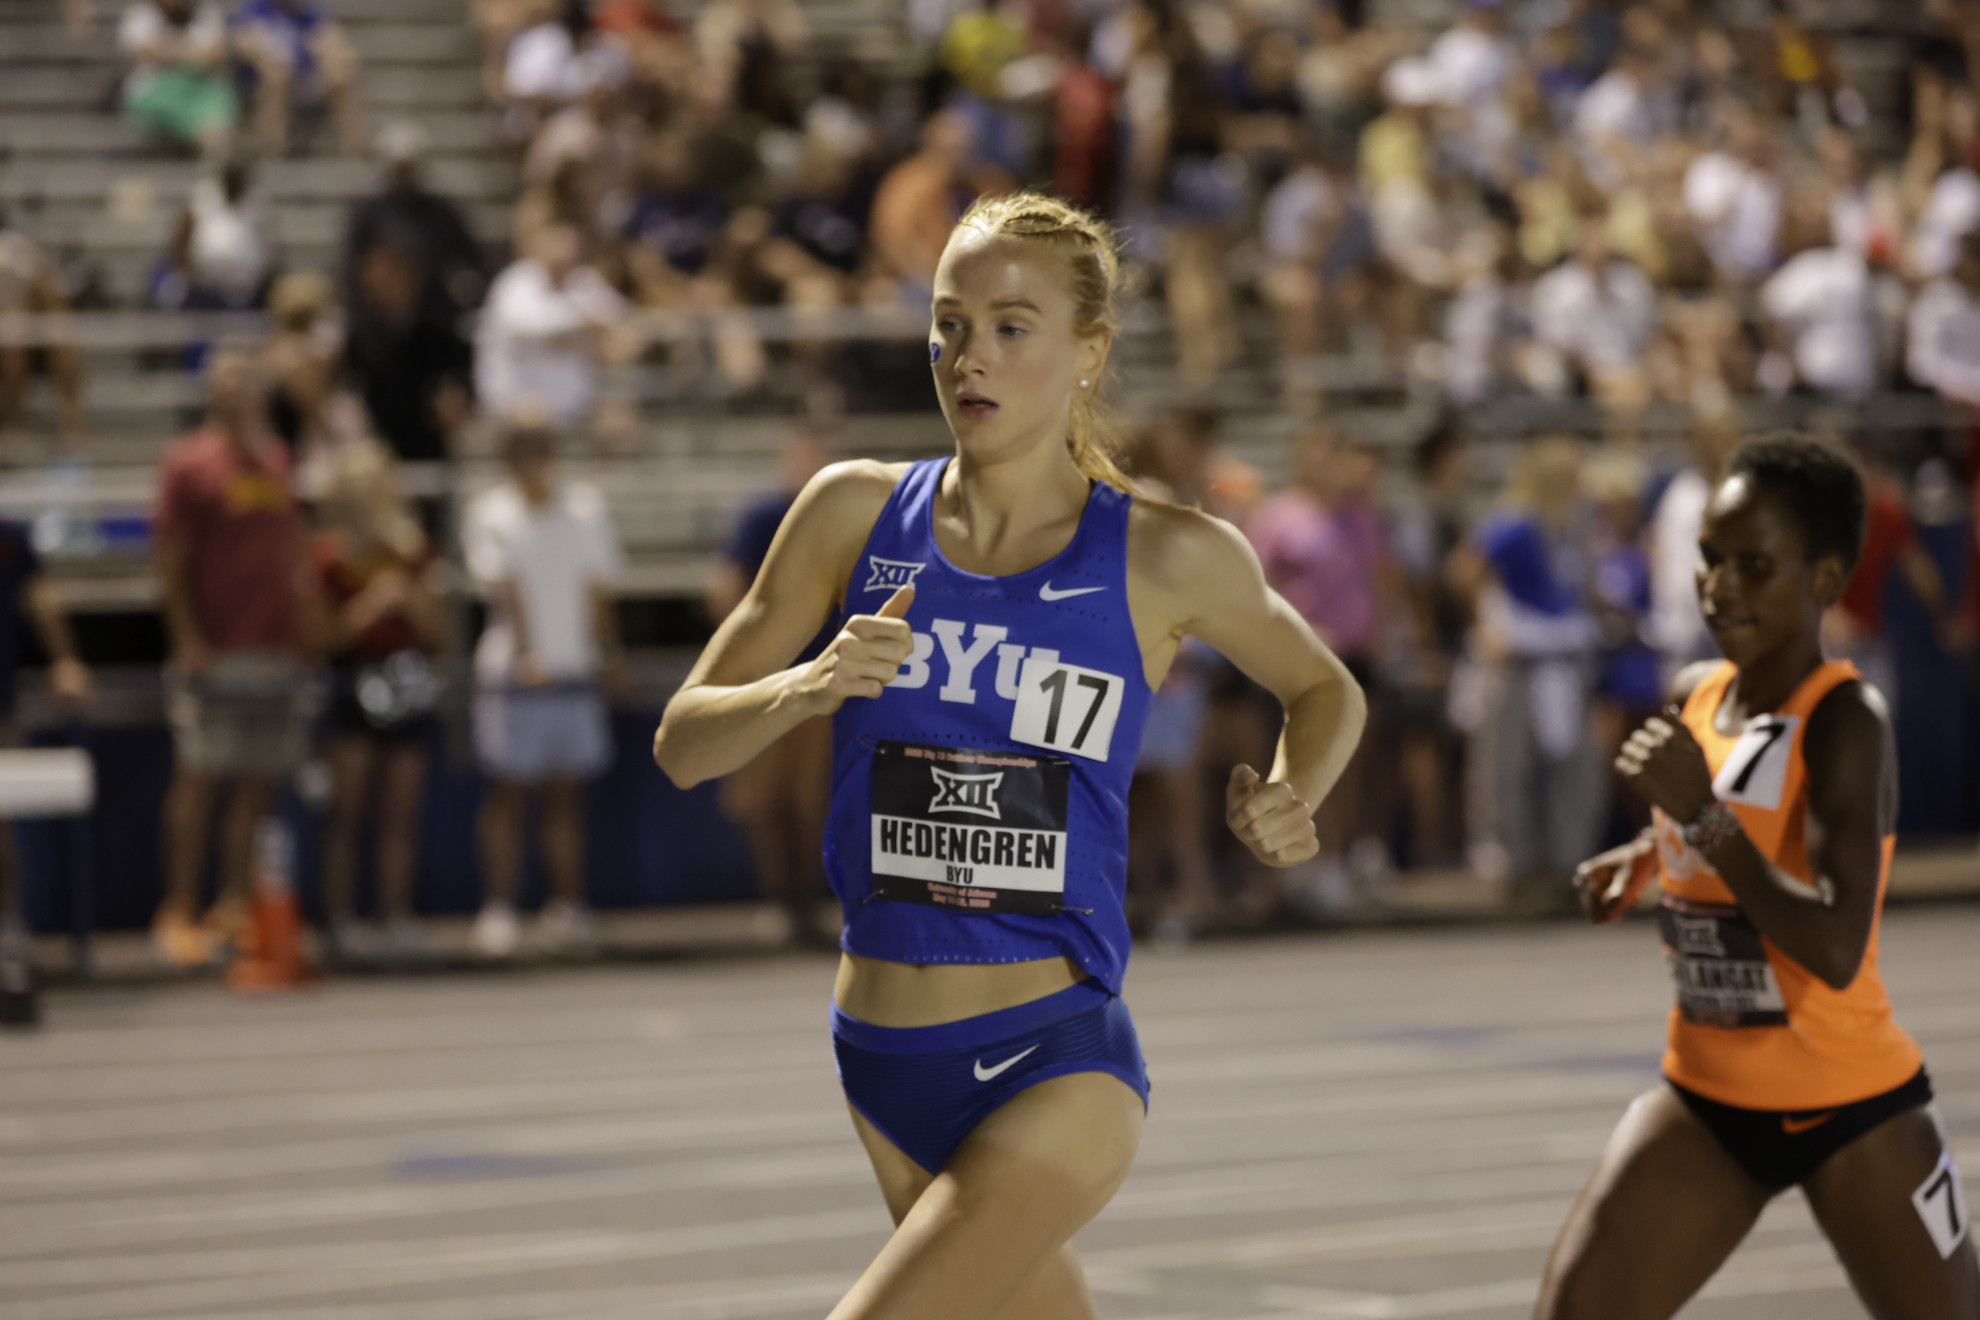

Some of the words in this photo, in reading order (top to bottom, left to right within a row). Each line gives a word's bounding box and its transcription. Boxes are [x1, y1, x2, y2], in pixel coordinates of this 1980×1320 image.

[866, 558, 920, 590] XII
[1039, 669, 1110, 750] 17
[1731, 724, 1785, 794] 7
[931, 769, 1001, 816] XII
[881, 819, 1056, 869] HEDENGREN
[946, 865, 973, 884] BYU
[1924, 1167, 1960, 1237] 7
